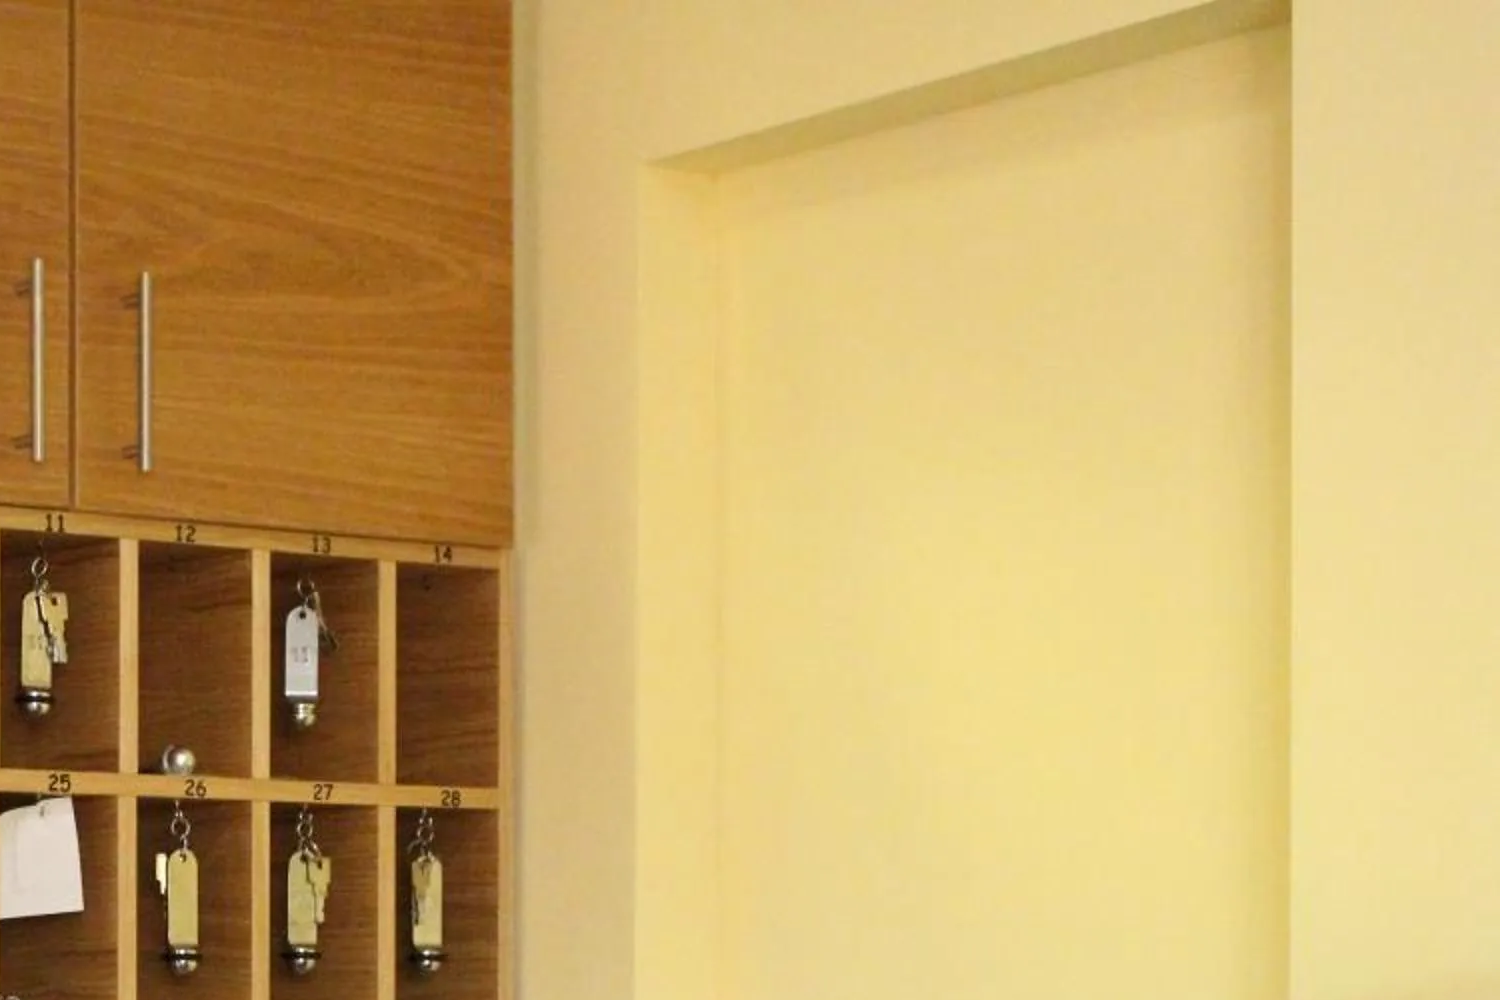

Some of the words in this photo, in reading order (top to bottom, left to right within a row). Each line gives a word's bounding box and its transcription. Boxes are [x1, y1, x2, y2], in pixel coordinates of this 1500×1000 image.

[45, 514, 66, 533] 11
[174, 524, 197, 543] 12
[311, 534, 331, 555] 13
[434, 545, 454, 563] 14
[48, 772, 72, 793] 25
[183, 779, 208, 799] 26
[312, 782, 334, 801] 27
[439, 788, 462, 809] 28
